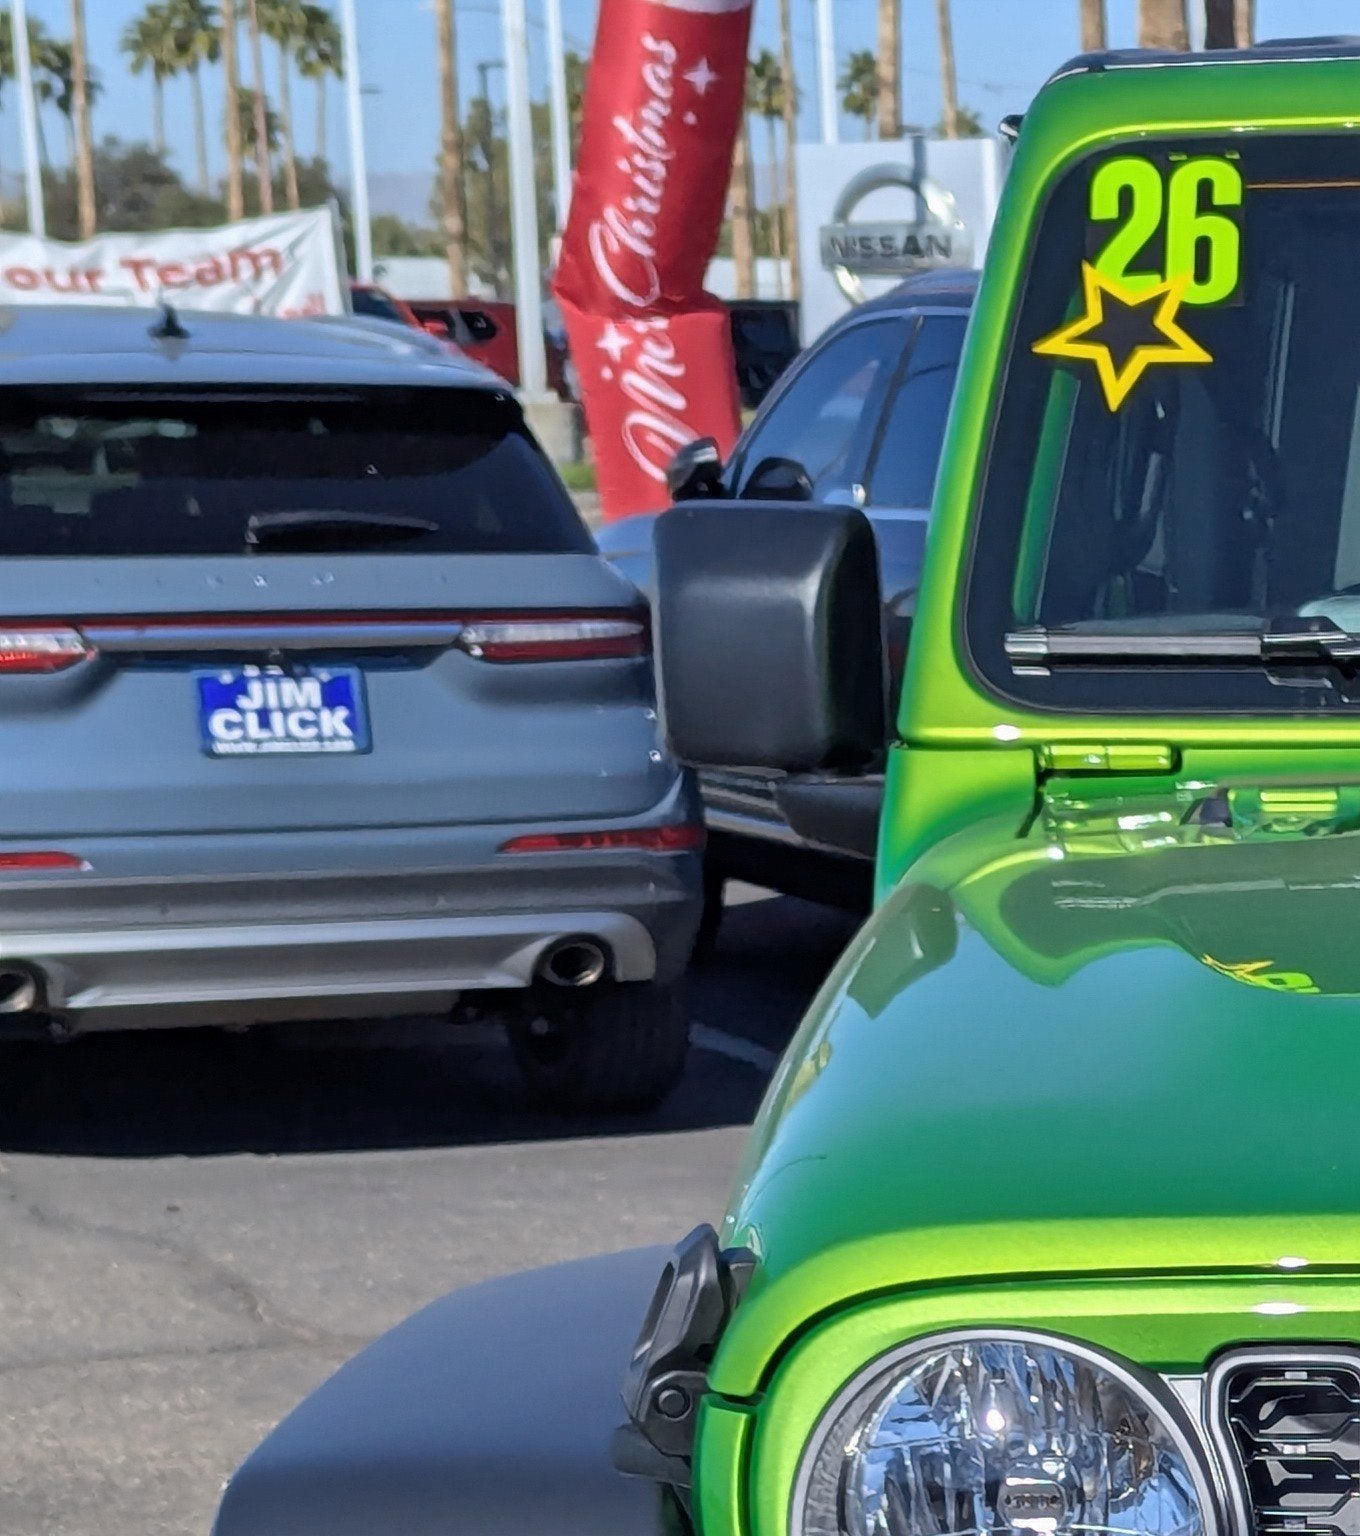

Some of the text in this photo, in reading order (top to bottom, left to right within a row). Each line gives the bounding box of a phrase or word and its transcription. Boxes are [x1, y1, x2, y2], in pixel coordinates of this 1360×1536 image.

[588, 30, 678, 308] Christmas
[830, 234, 953, 259] NISSAN
[1090, 158, 1242, 304] 26
[4, 248, 282, 293] our Team
[236, 677, 323, 710] JIM
[208, 706, 354, 741] CLICK
